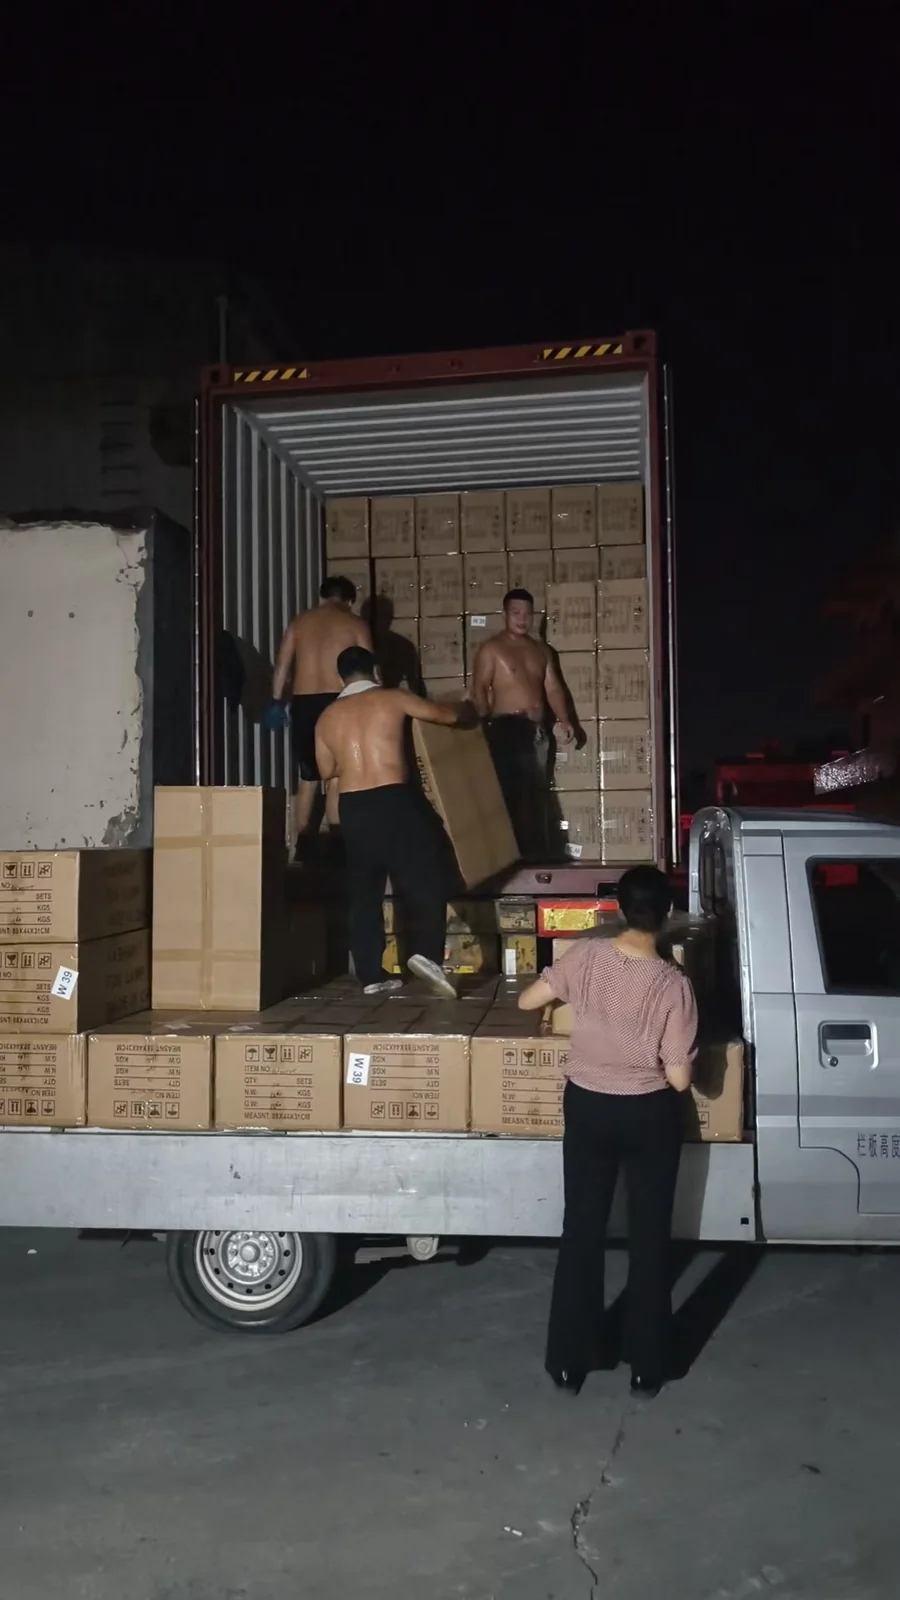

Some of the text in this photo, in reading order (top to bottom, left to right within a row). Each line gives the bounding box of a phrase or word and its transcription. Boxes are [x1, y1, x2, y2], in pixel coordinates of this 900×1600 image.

[36, 892, 52, 900] SETS
[36, 983, 51, 991] SETS
[57, 971, 72, 995] W 39
[37, 994, 50, 1002] KGS
[116, 1067, 128, 1075] KGS
[352, 1057, 364, 1084] W 39
[502, 1068, 517, 1076] ITEM
[296, 1077, 312, 1085] SETS
[372, 1079, 387, 1087] SETS
[42, 1089, 56, 1097] ITEM
[166, 1091, 180, 1099] ITEM
